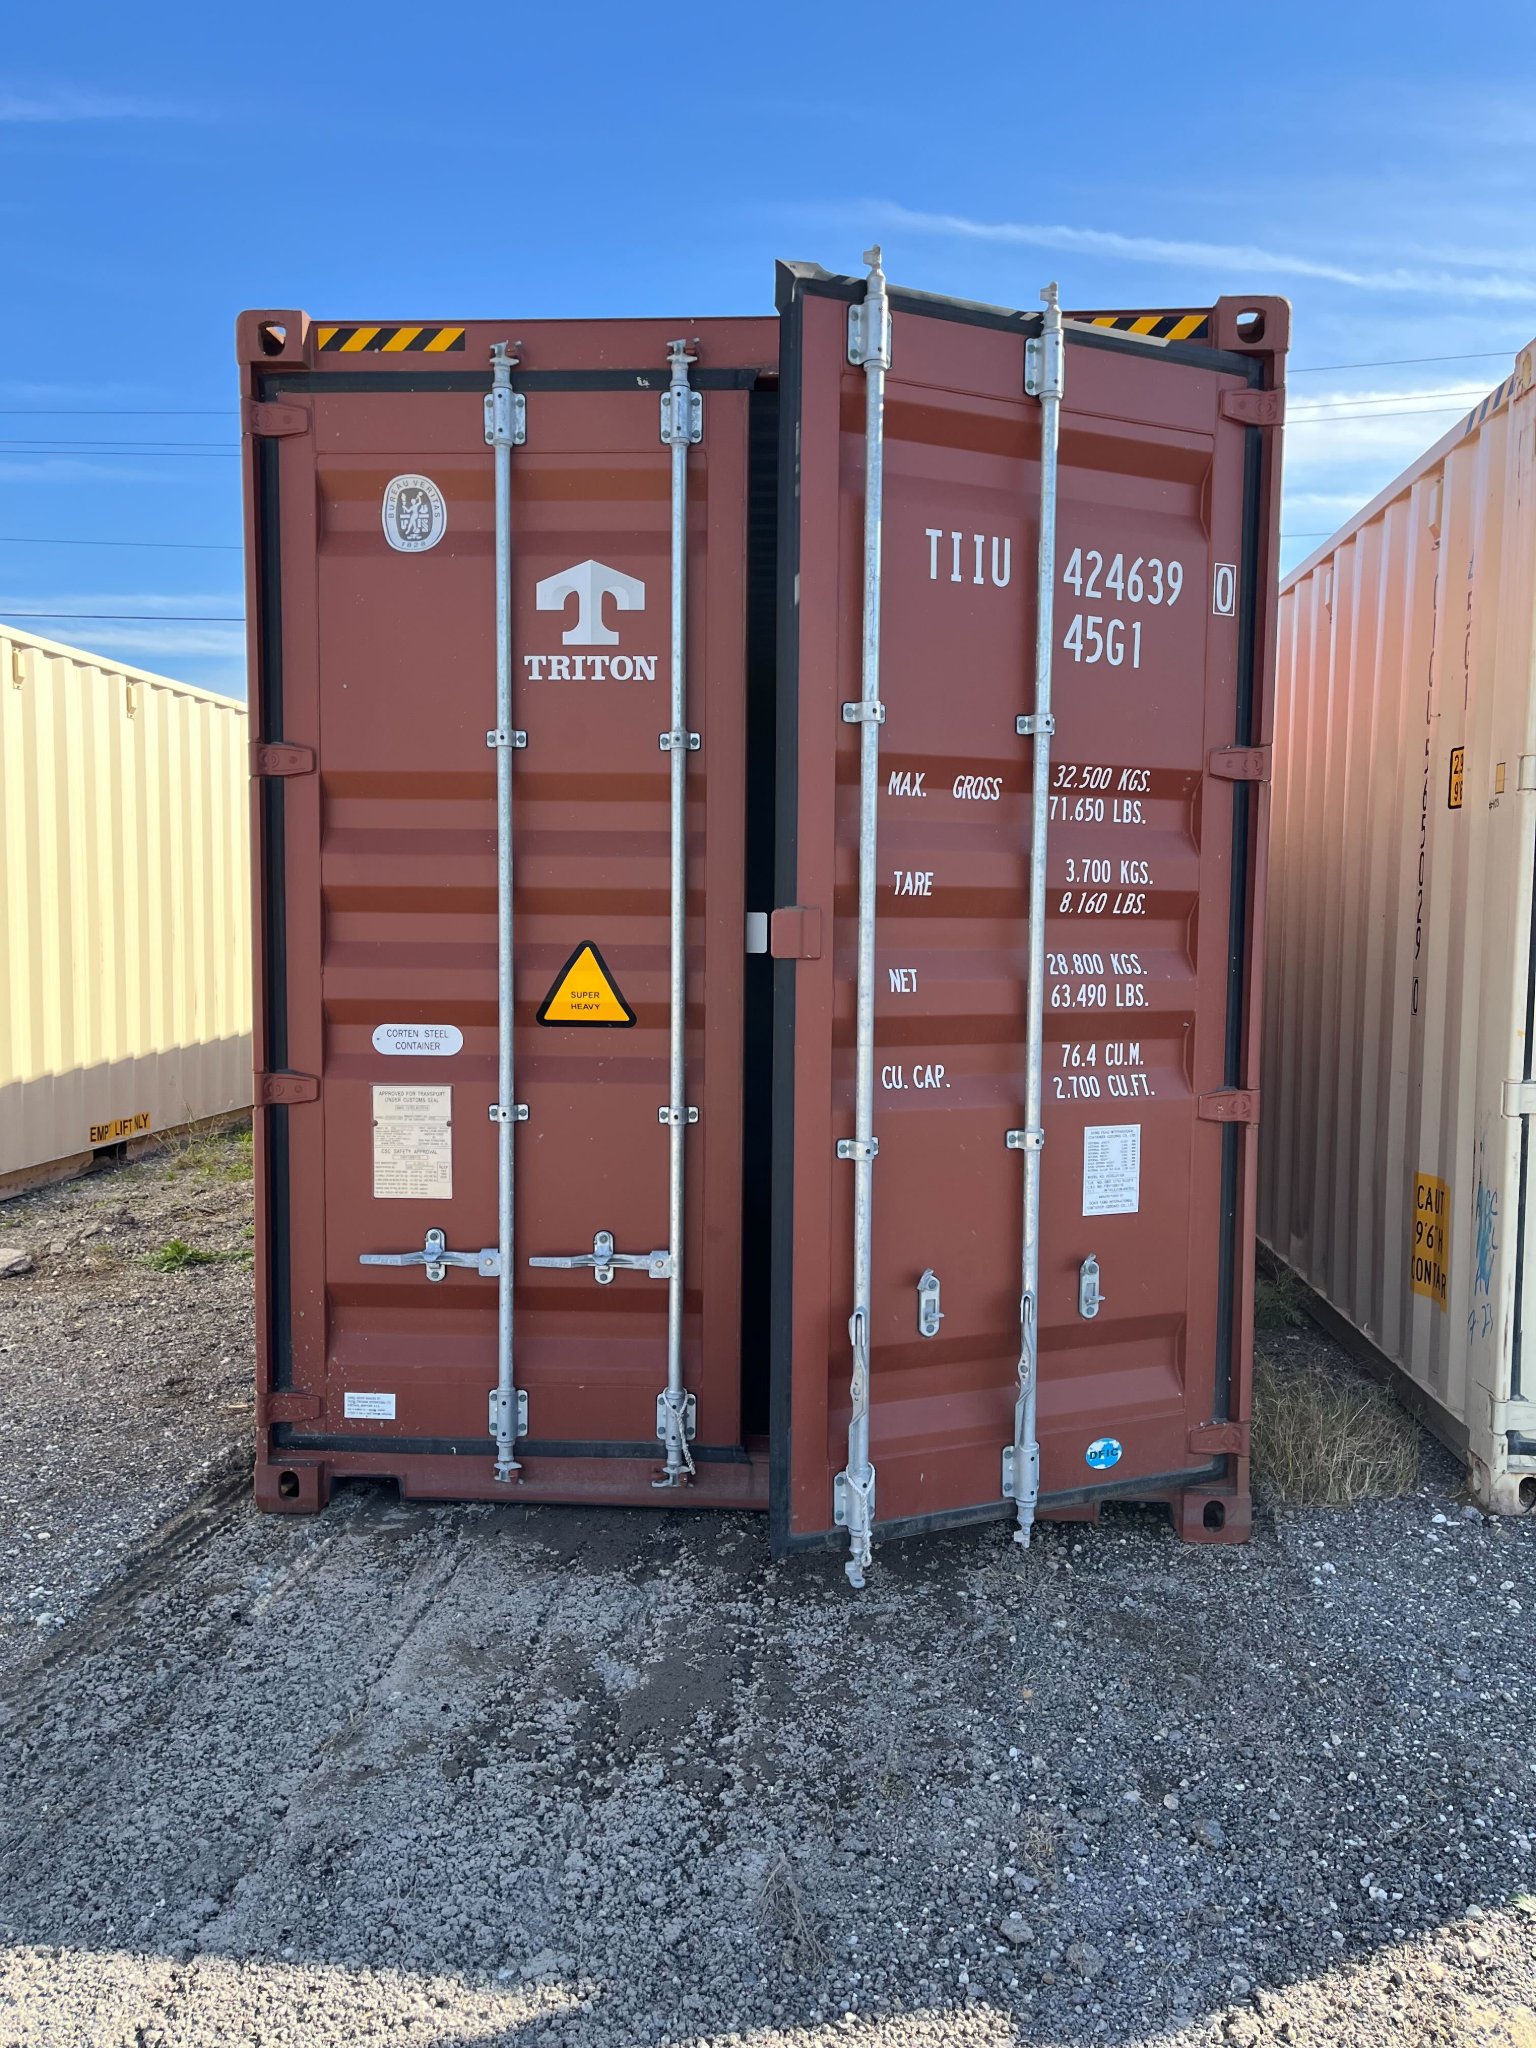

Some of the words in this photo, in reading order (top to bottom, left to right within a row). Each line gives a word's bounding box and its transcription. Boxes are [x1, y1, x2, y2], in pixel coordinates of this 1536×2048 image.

[925, 528, 1011, 588] TIIU
[1063, 547, 1183, 606] 424639
[1063, 614, 1141, 669] 45G1
[523, 655, 658, 681] TRITON
[888, 771, 927, 797] MAX.
[953, 775, 1003, 800] GROSS
[1053, 764, 1112, 789] 32,500
[1117, 768, 1150, 792] KGS.
[1049, 796, 1104, 822] 71,650
[1113, 799, 1146, 824] LBS.
[894, 870, 934, 896] TARE
[1066, 858, 1111, 882] 3,700
[1120, 860, 1153, 885] KGS.
[1059, 891, 1108, 914] 8,160
[1113, 892, 1145, 915] LBS.
[888, 968, 917, 993] NET
[1046, 953, 1104, 975] 28,800
[1110, 953, 1147, 975] KGS.
[570, 991, 600, 999] SUPER
[1051, 983, 1107, 1007] 63,490
[1116, 983, 1149, 1007] LBS.
[386, 1029, 419, 1038] CORTEN
[424, 1029, 448, 1039] STEEL
[395, 1041, 441, 1050] CONTAINER
[881, 1065, 908, 1089] CU.
[913, 1064, 951, 1088] CAP.
[1062, 1043, 1096, 1067] 76.4
[115, 1119, 132, 1136] LIFT
[1090, 1447, 1119, 1460] DFIC
